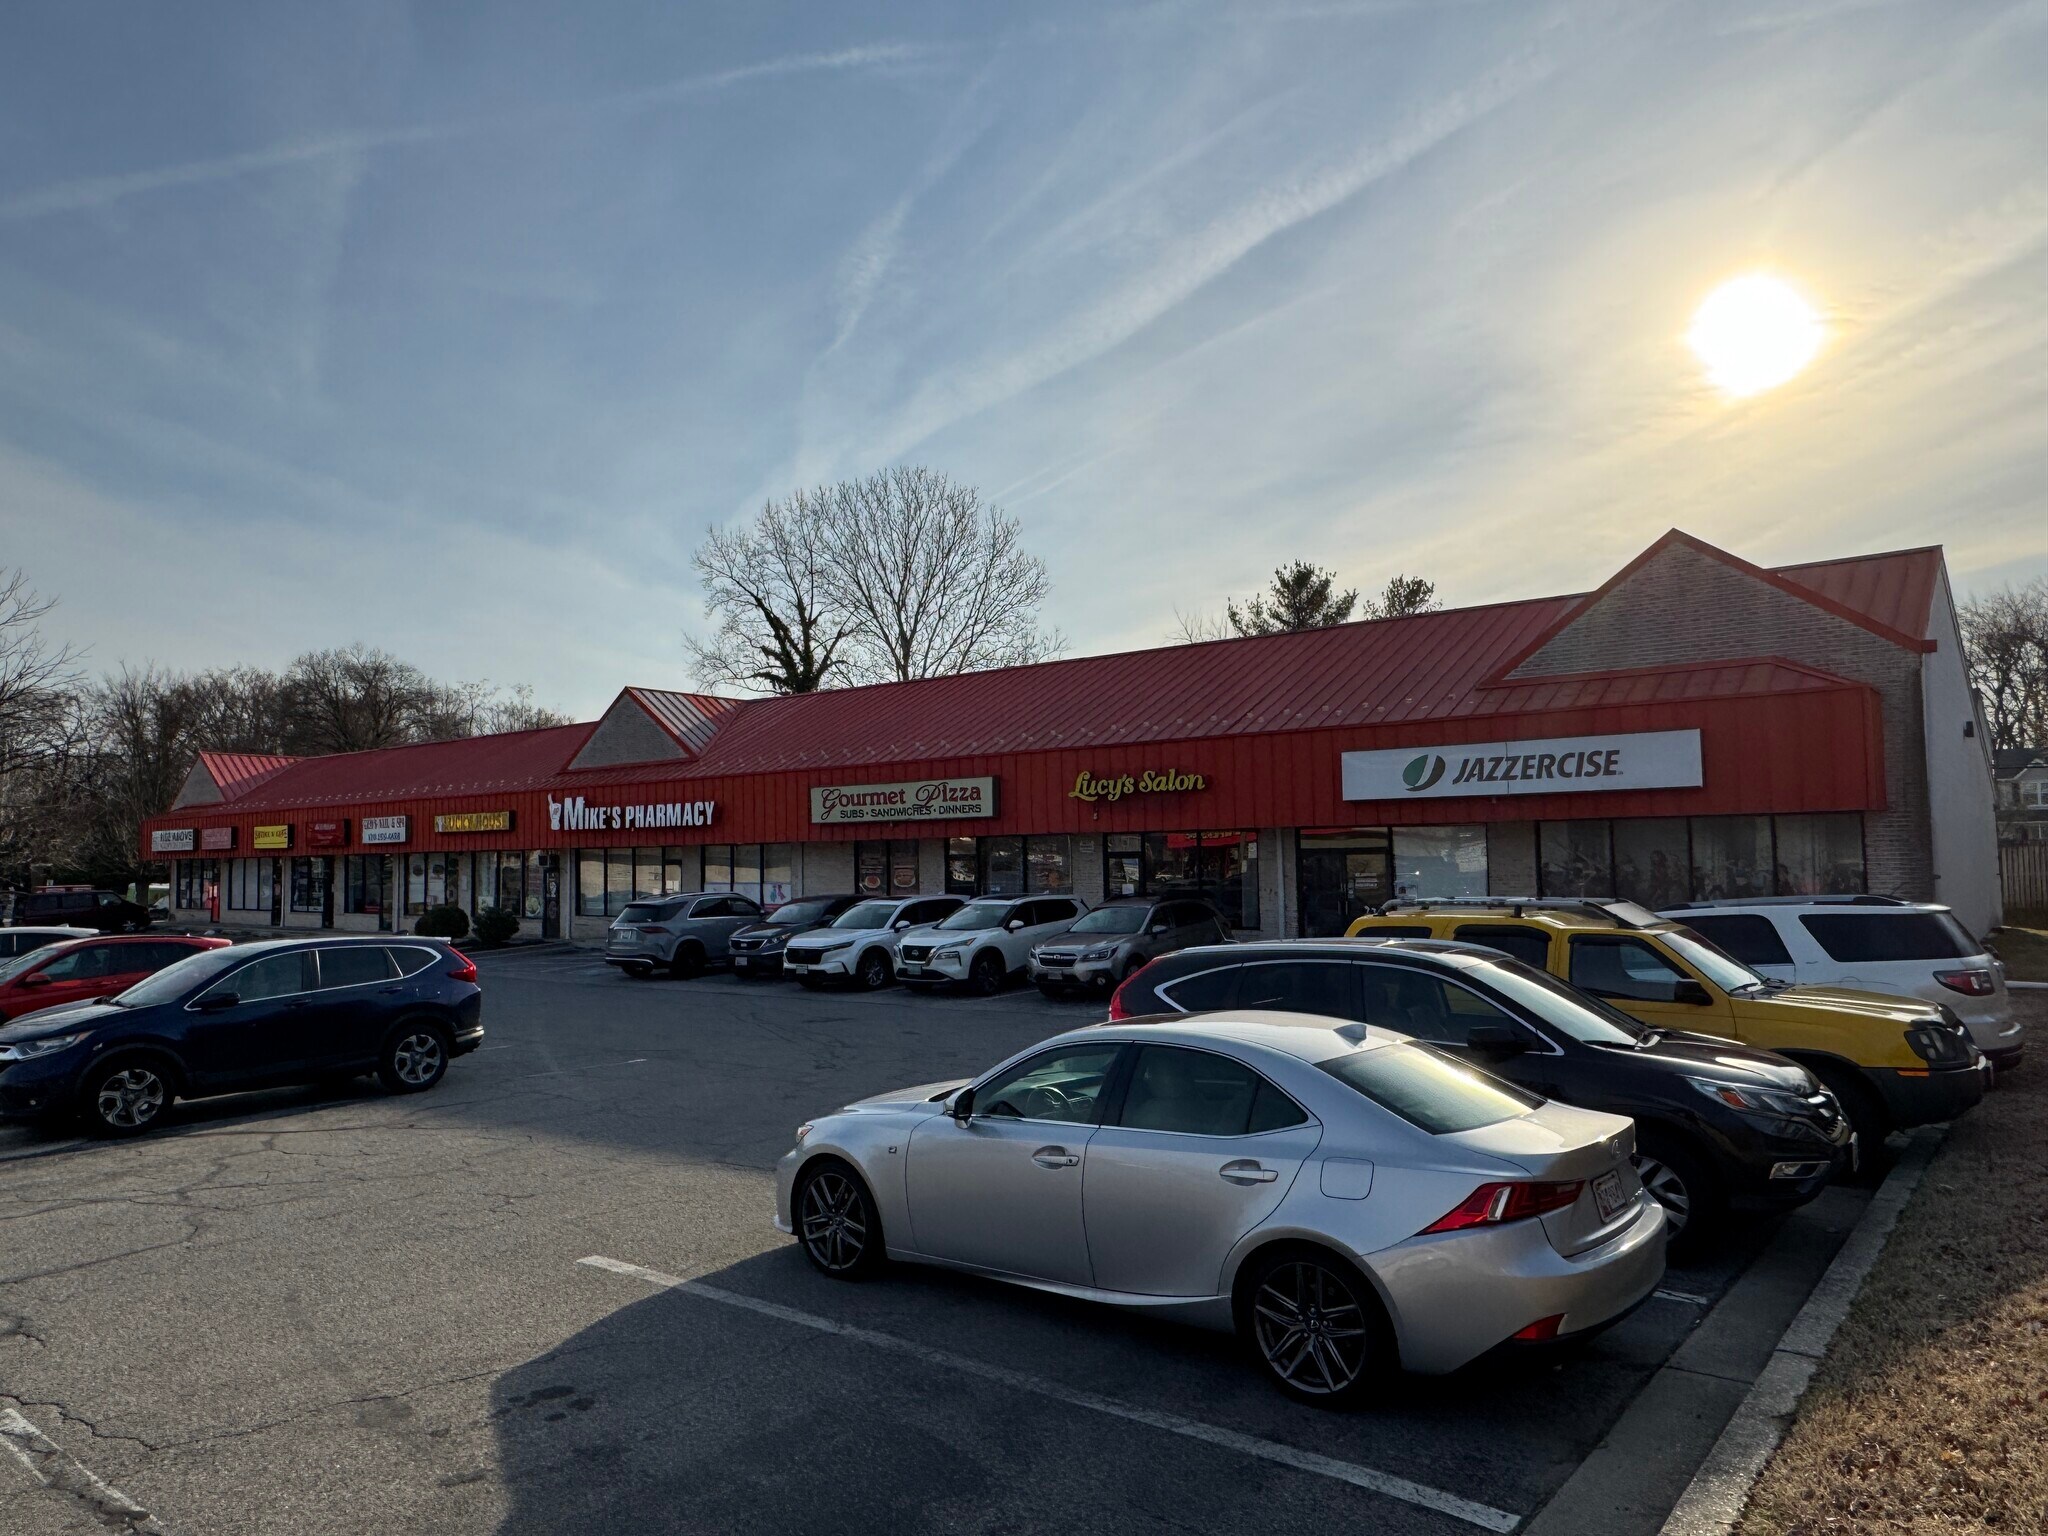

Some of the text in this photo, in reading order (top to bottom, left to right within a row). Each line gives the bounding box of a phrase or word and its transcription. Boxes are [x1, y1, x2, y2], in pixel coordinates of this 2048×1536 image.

[1452, 749, 1620, 785] JAZZERCISE
[821, 782, 982, 820] Gourmet Pizza
[1068, 768, 1205, 801] Lucy's Salon
[625, 801, 715, 829] PHARMACY
[840, 804, 982, 818] SUBS SANDWICHES DINNERS
